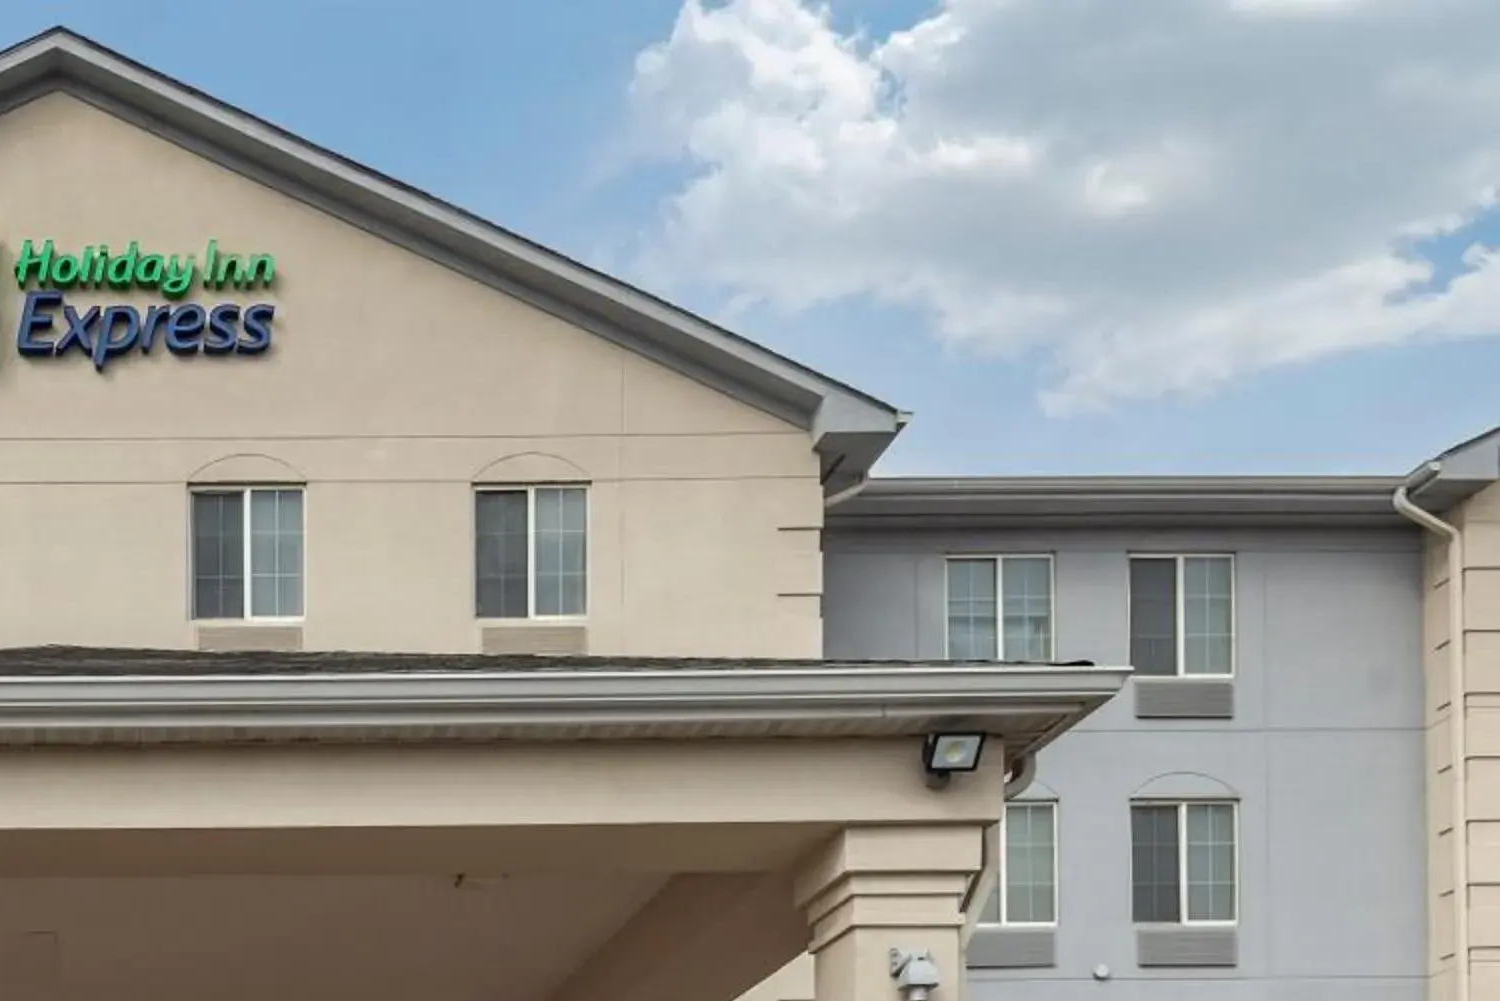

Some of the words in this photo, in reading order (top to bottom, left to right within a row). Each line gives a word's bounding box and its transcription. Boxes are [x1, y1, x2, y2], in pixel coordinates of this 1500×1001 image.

[14, 240, 196, 298] Holiday
[203, 239, 275, 289] Inn
[17, 290, 275, 371] Express
